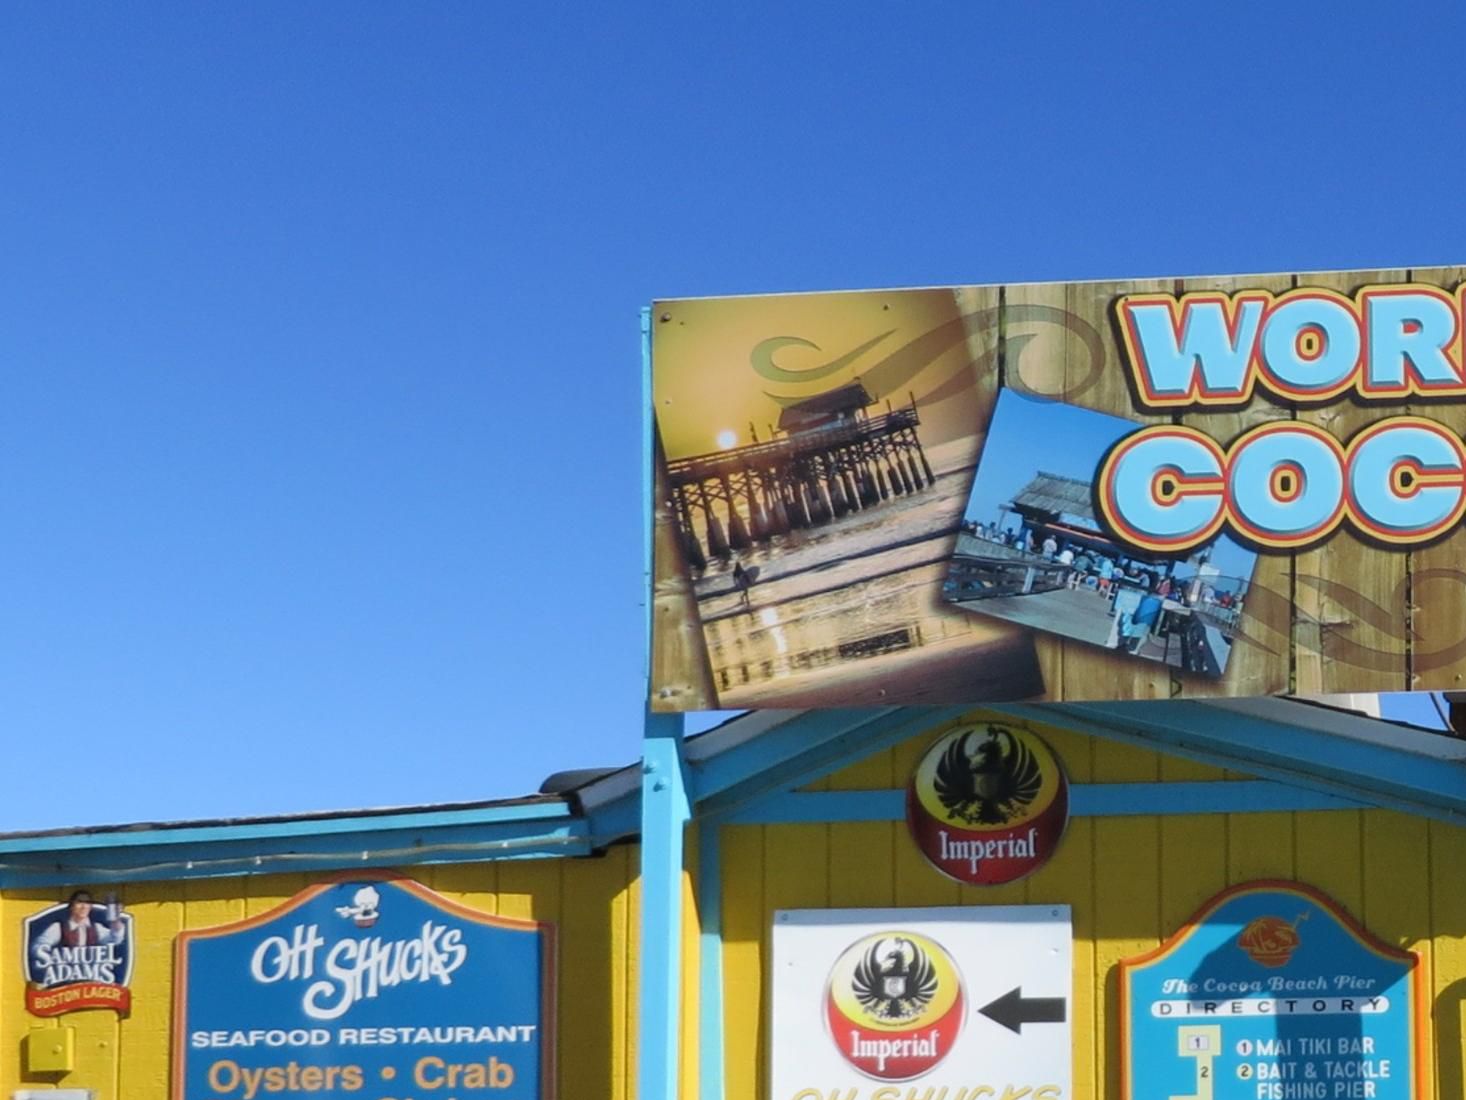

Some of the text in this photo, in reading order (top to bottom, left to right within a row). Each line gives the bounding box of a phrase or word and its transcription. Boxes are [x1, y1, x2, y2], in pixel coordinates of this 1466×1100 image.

[938, 828, 1037, 875] Imperial
[35, 943, 123, 968] SAMUEL
[43, 963, 115, 986] ADAMS
[1162, 975, 1376, 994] The Cocoa Beach Pier
[34, 986, 124, 1009] BOSTON LAGER
[1159, 998, 1381, 1015] DIRECTORY
[192, 1025, 536, 1048] SEAFOOD RESTAURANT
[1256, 1039, 1291, 1056] MAI
[1298, 1038, 1331, 1055] TIKI
[1337, 1037, 1375, 1054] BAR
[851, 1028, 940, 1071] Imperial
[208, 1056, 515, 1100] Oysters Crab
[1200, 1066, 1209, 1078] 2
[1257, 1062, 1297, 1080] BAIT
[1304, 1062, 1317, 1078] &
[1324, 1060, 1391, 1078] TACKLE
[1257, 1081, 1376, 1100] FISHING PIER
